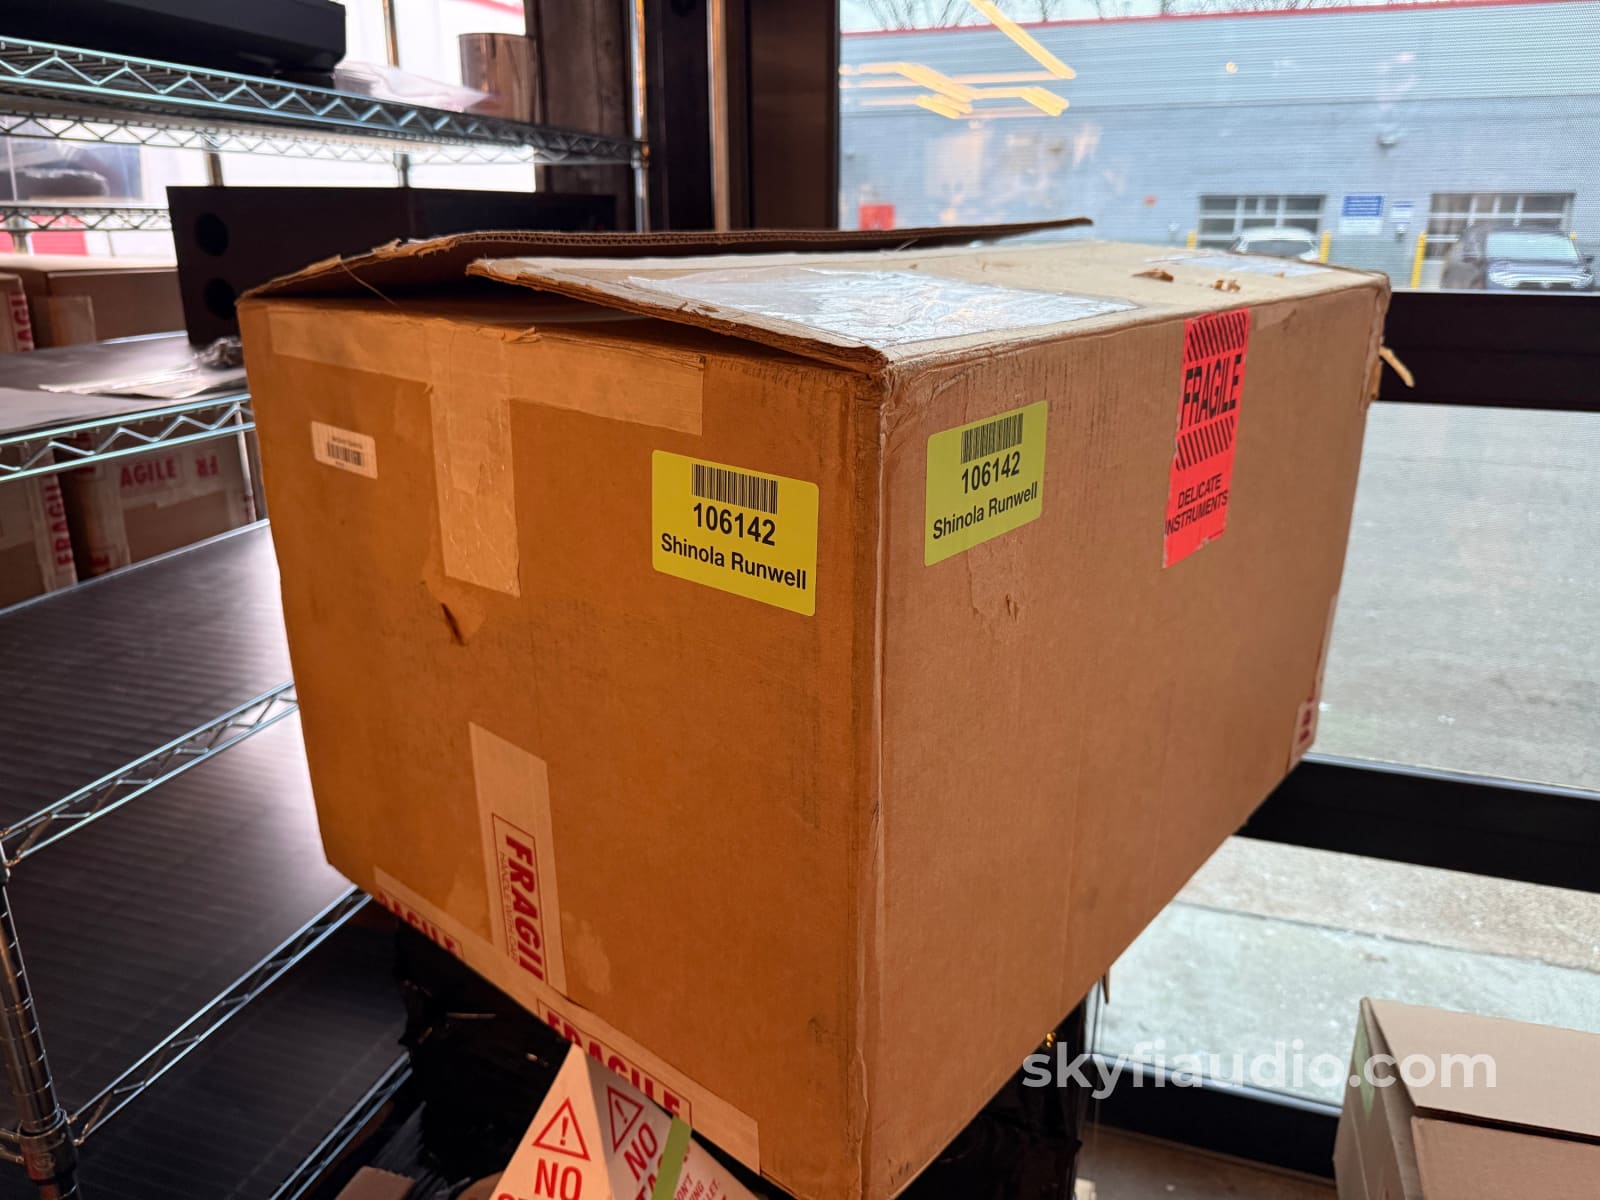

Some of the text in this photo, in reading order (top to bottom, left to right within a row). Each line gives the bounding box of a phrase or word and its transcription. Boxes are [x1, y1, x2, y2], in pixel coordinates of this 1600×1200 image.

[1180, 353, 1242, 430] FRAGILE
[961, 450, 1021, 494] 106142
[1178, 473, 1222, 510] DELICATE
[693, 502, 776, 546] 106142
[932, 481, 1038, 540] Shinola Runwell
[1165, 490, 1228, 536] INSTRUMENTS
[661, 533, 807, 590] Shinola Runwell
[624, 1122, 658, 1182] NO
[534, 1158, 583, 1200] NO
